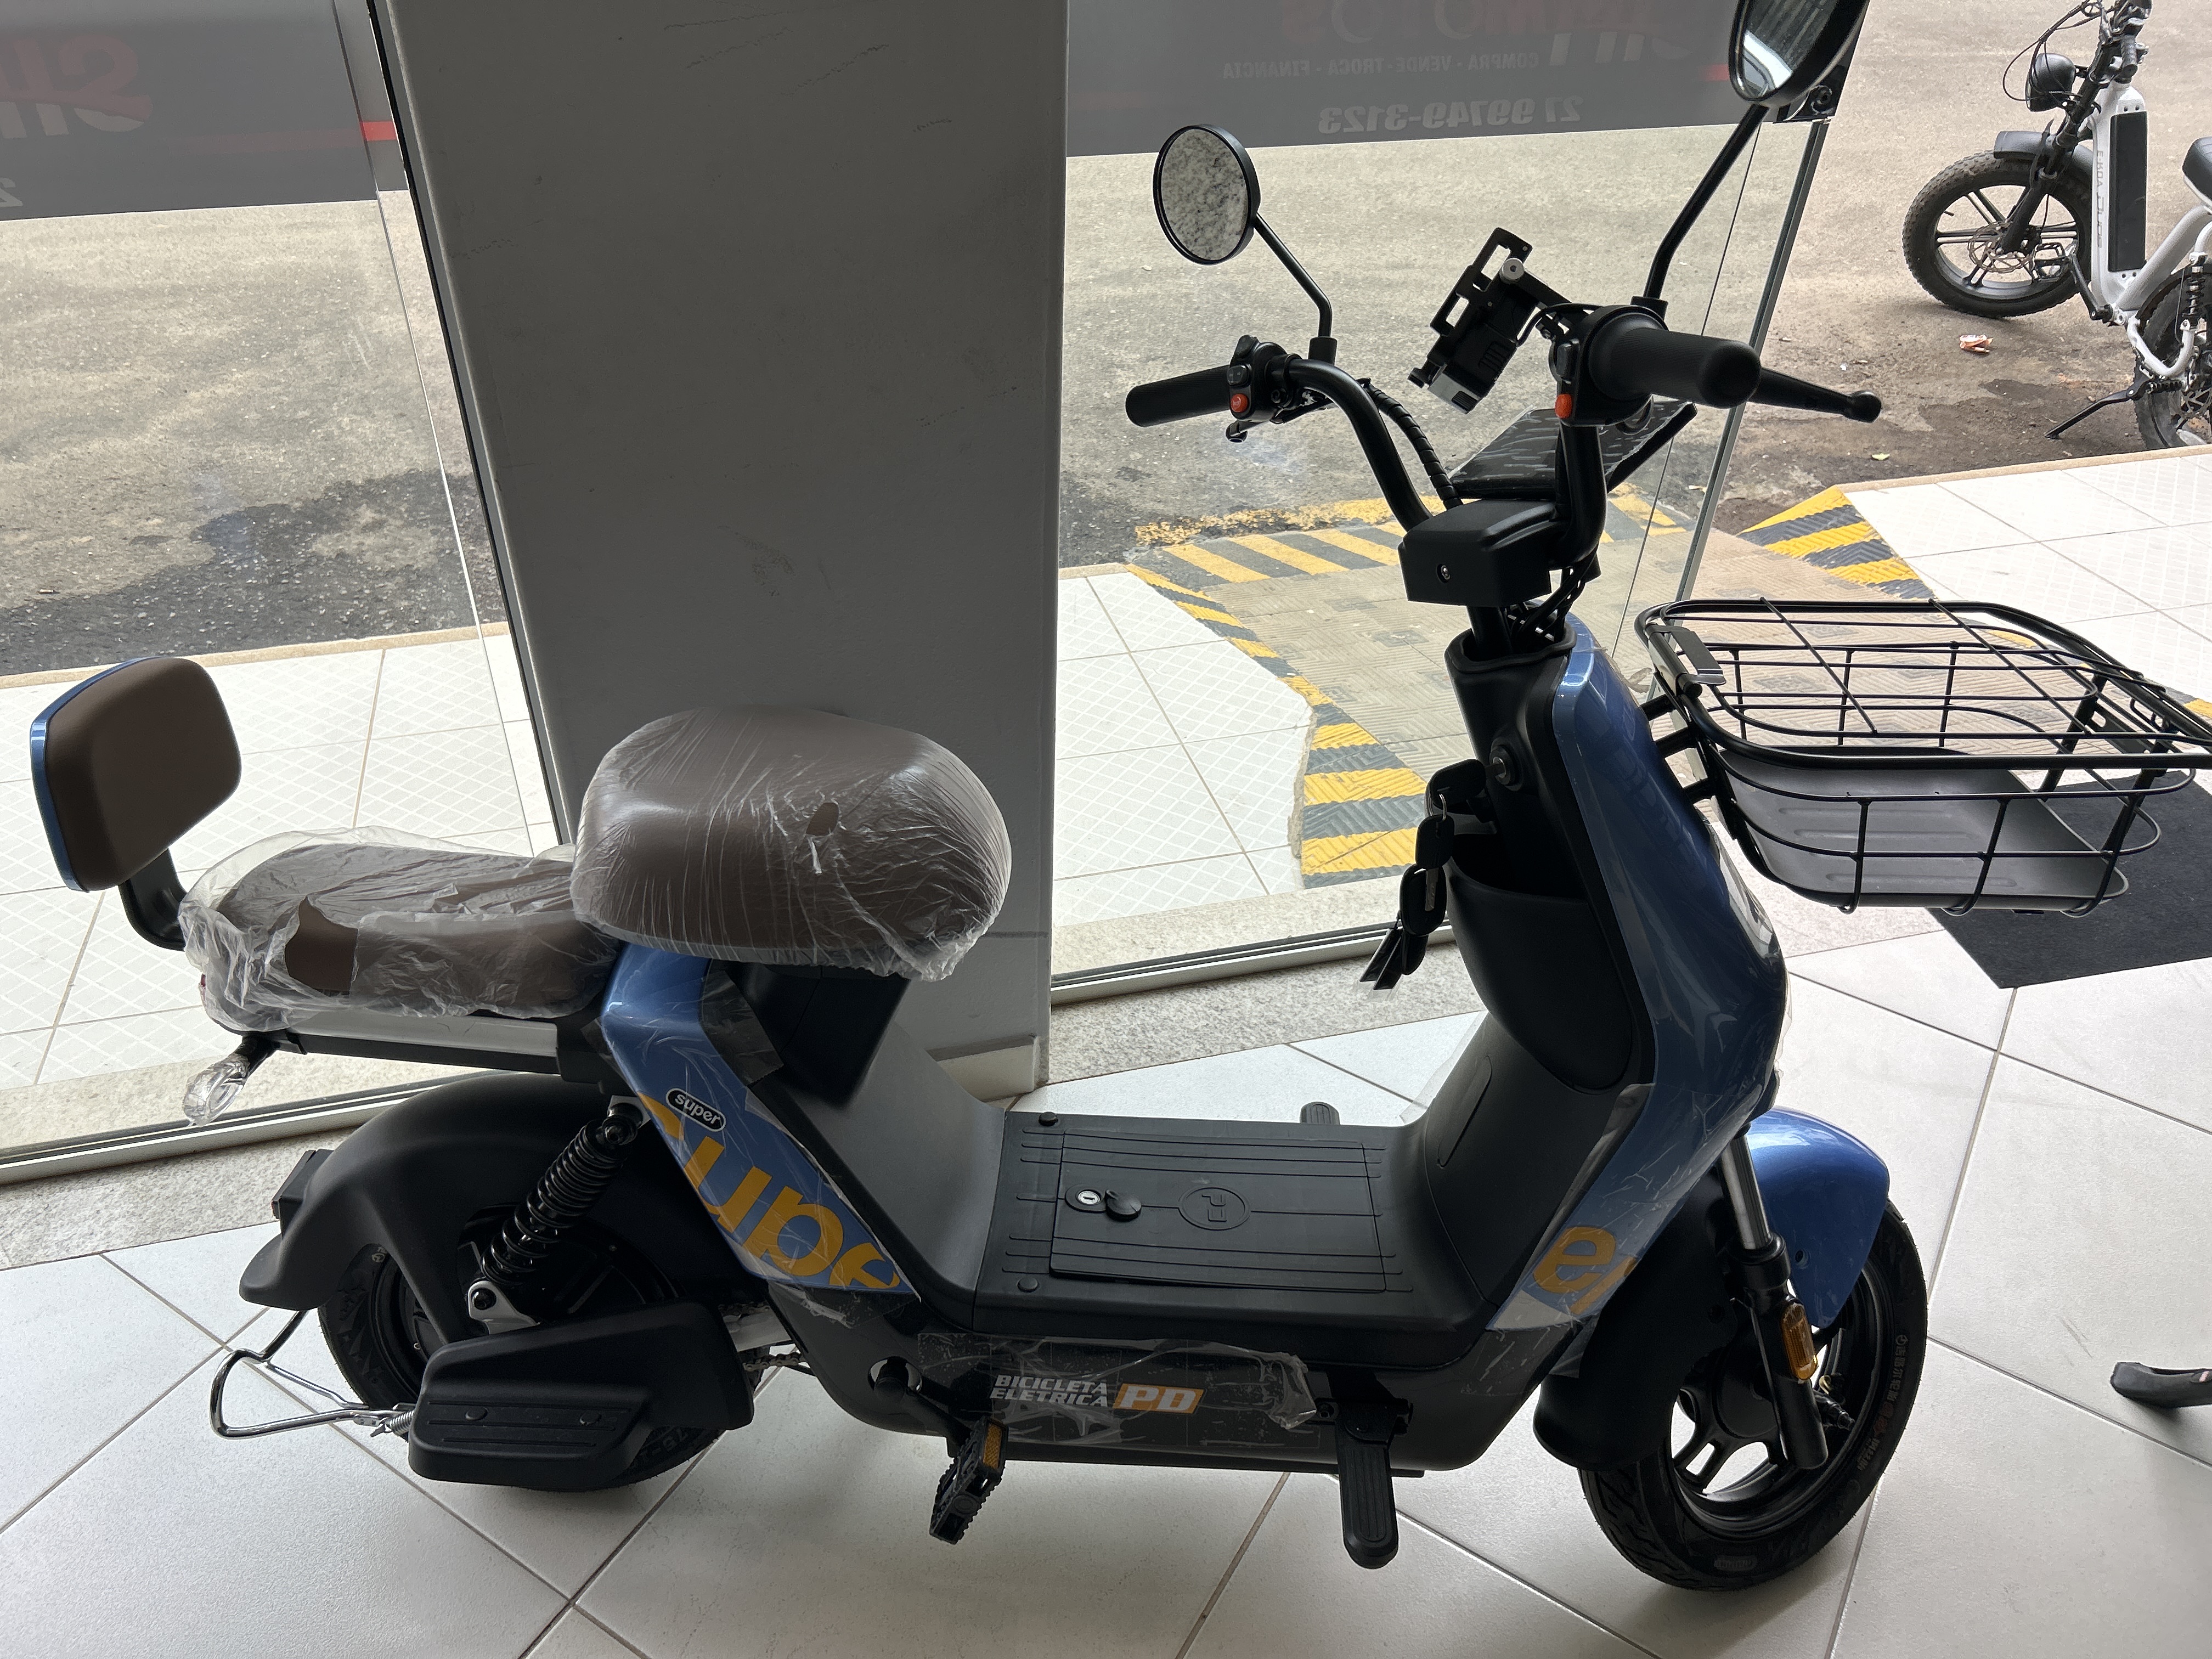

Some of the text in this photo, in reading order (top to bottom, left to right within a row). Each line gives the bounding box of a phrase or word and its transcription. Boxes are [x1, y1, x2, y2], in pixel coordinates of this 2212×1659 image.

[675, 1093, 721, 1125] super
[636, 1092, 900, 1289] upe
[989, 1387, 1108, 1408] ELETRICA
[995, 1374, 1108, 1395] BICICLETA
[1120, 1385, 1198, 1412] PD
